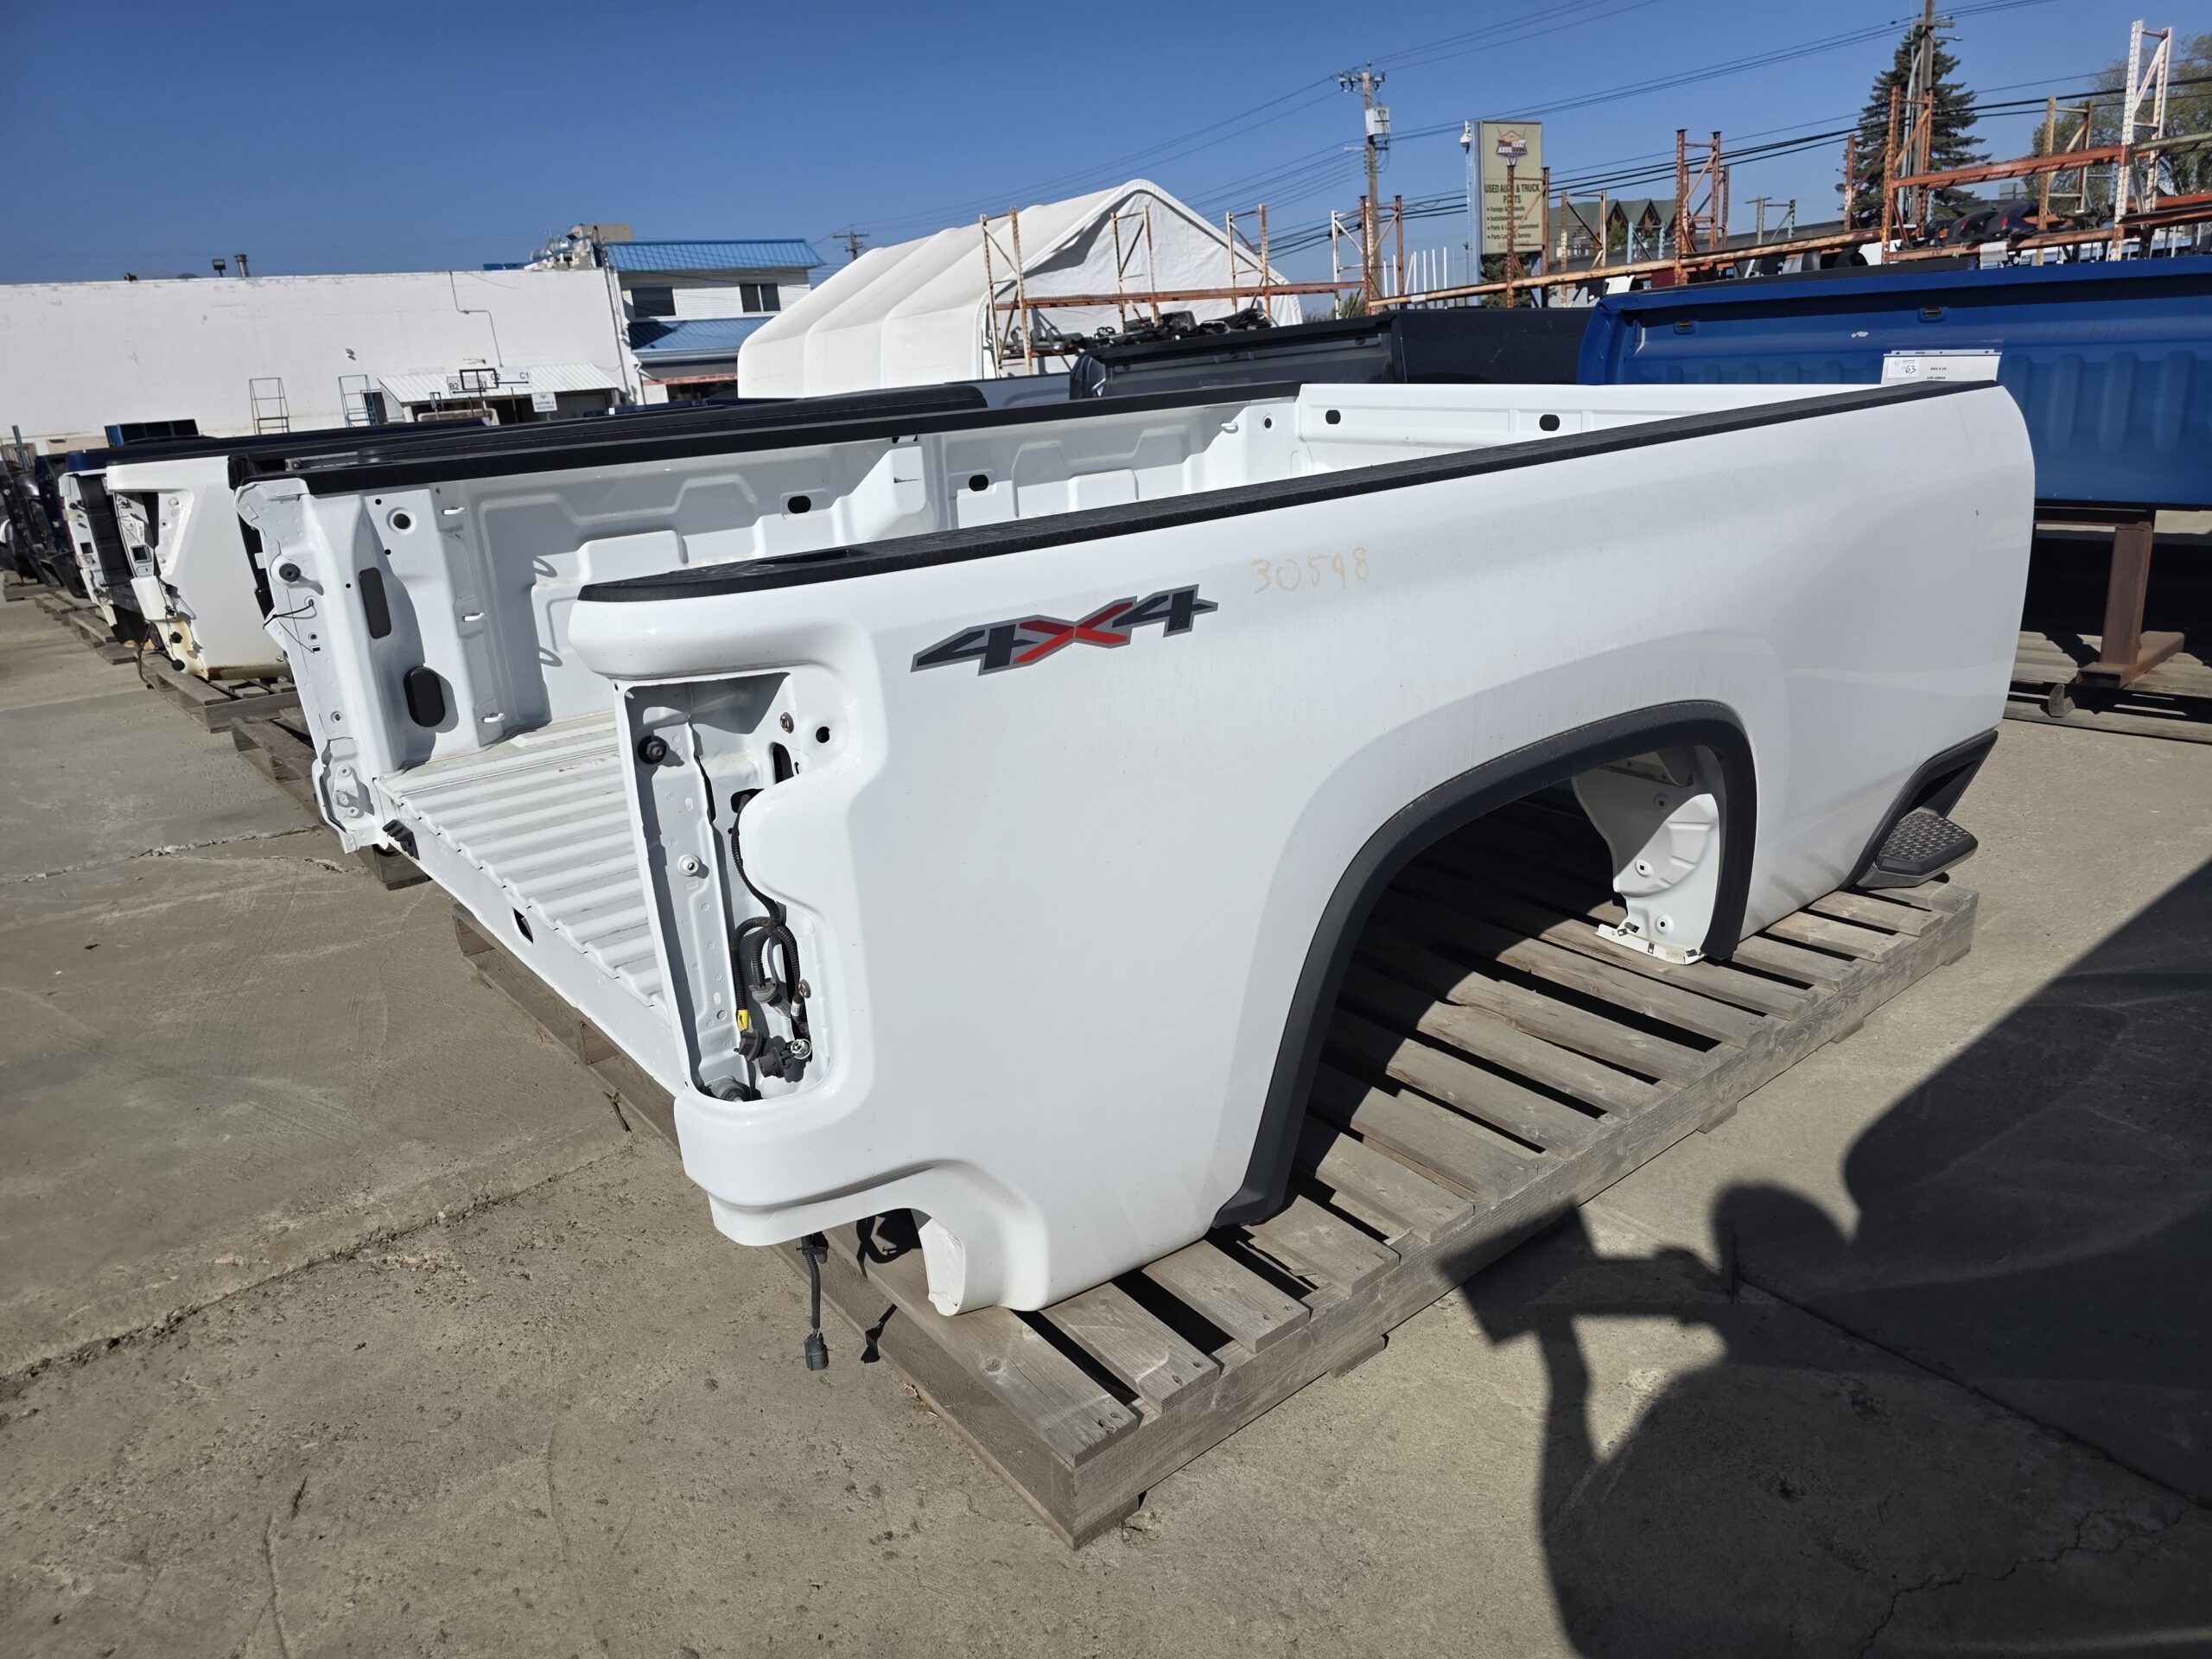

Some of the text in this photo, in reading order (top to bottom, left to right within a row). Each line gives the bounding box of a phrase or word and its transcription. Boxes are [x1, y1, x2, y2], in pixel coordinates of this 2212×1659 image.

[1484, 184, 1499, 193] USED
[1516, 184, 1520, 193] &
[1522, 183, 1540, 192] TRUCK
[1503, 194, 1521, 203] PTS
[1905, 365, 1917, 374] 63
[1251, 546, 1369, 594] 30598
